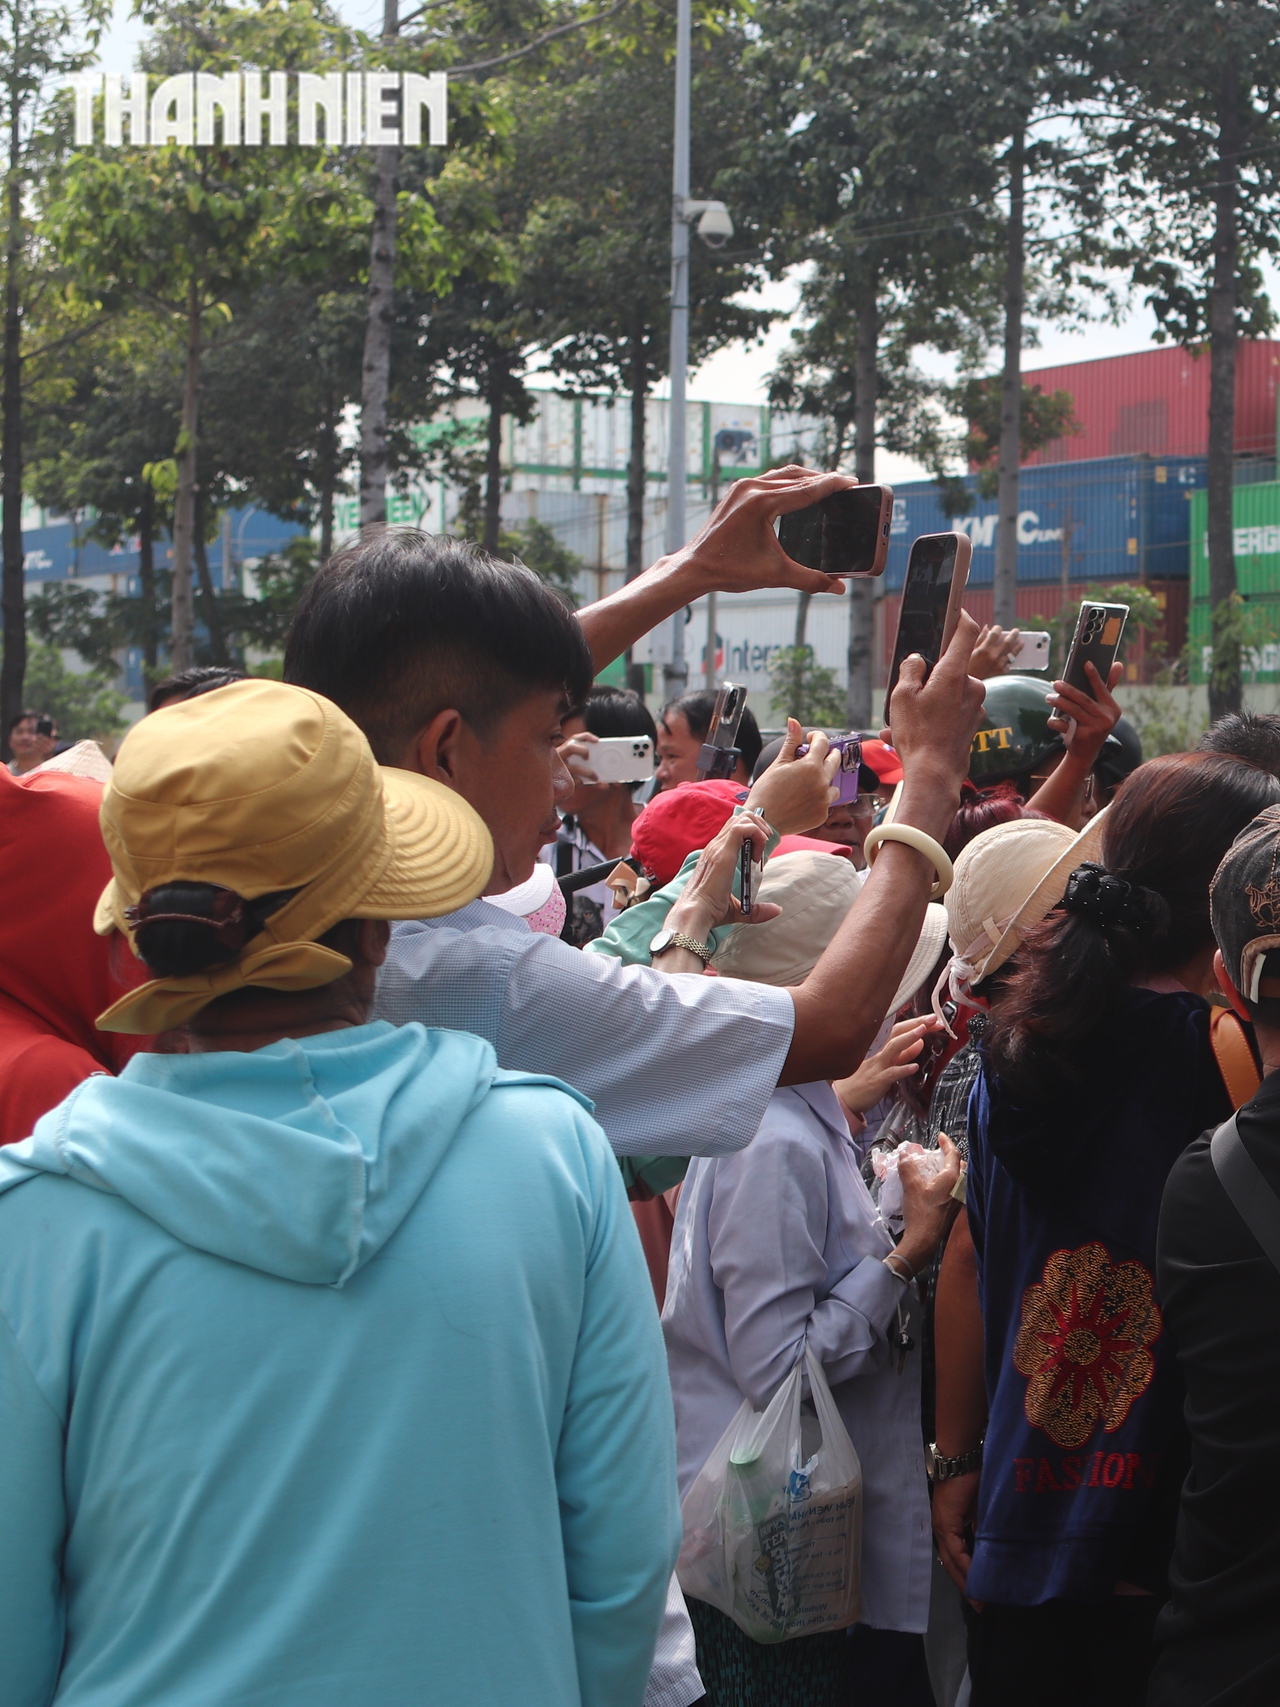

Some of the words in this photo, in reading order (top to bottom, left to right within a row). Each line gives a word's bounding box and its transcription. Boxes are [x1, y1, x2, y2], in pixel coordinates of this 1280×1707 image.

[952, 510, 1040, 548] KMC
[969, 727, 1013, 754] TT
[763, 1530, 788, 1551] TEA
